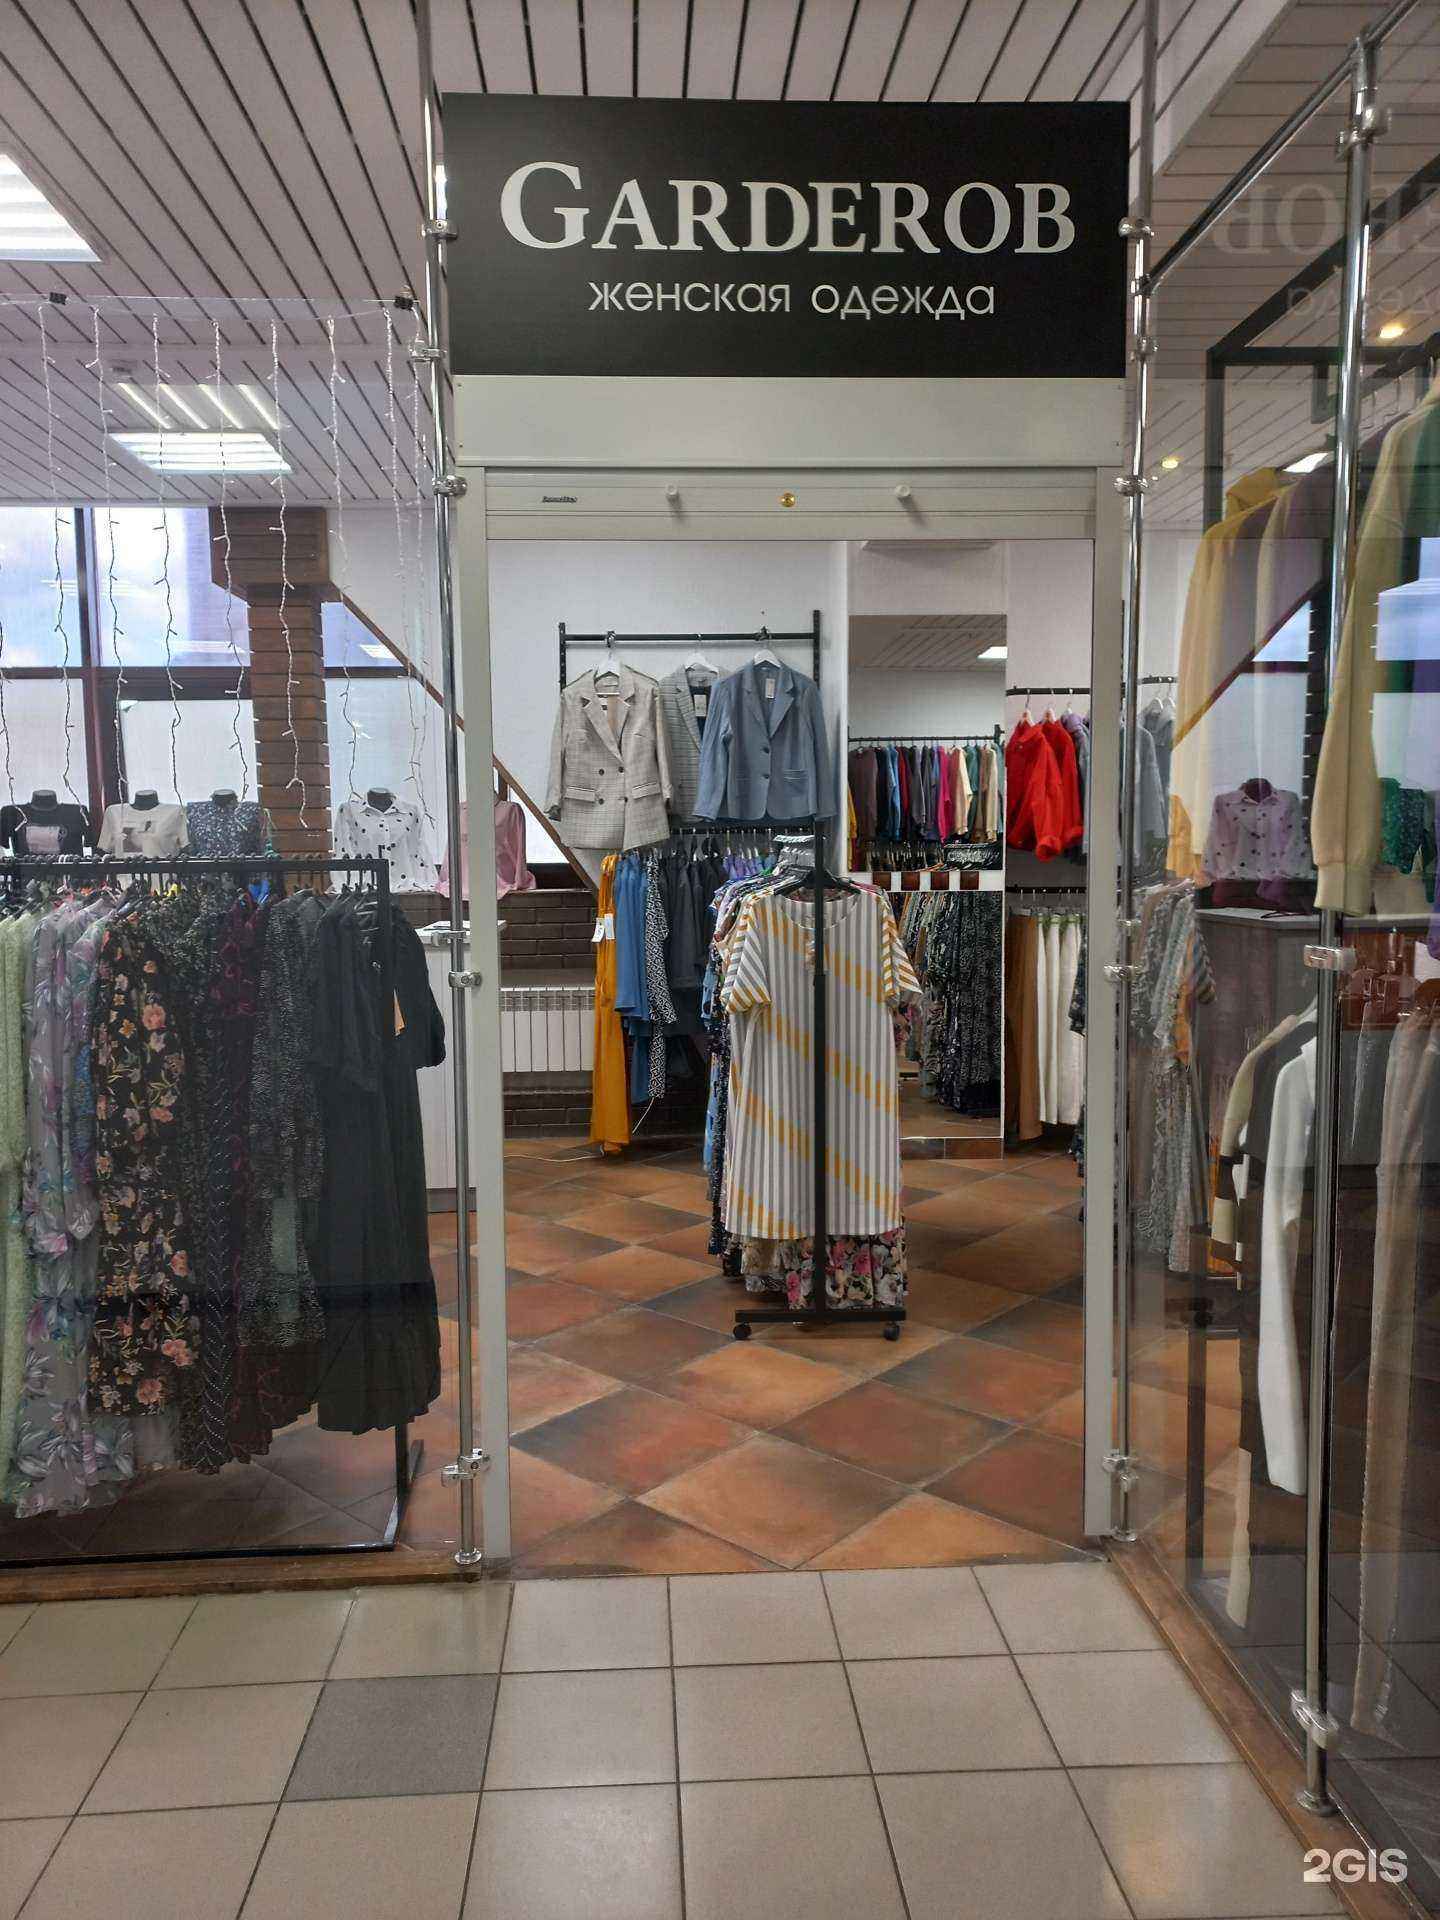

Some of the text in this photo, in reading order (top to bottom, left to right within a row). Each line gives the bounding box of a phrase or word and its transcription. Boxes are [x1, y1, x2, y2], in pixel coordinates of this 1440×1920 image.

[499, 161, 1076, 256] GARDEROB
[588, 281, 996, 320] женская одежда
